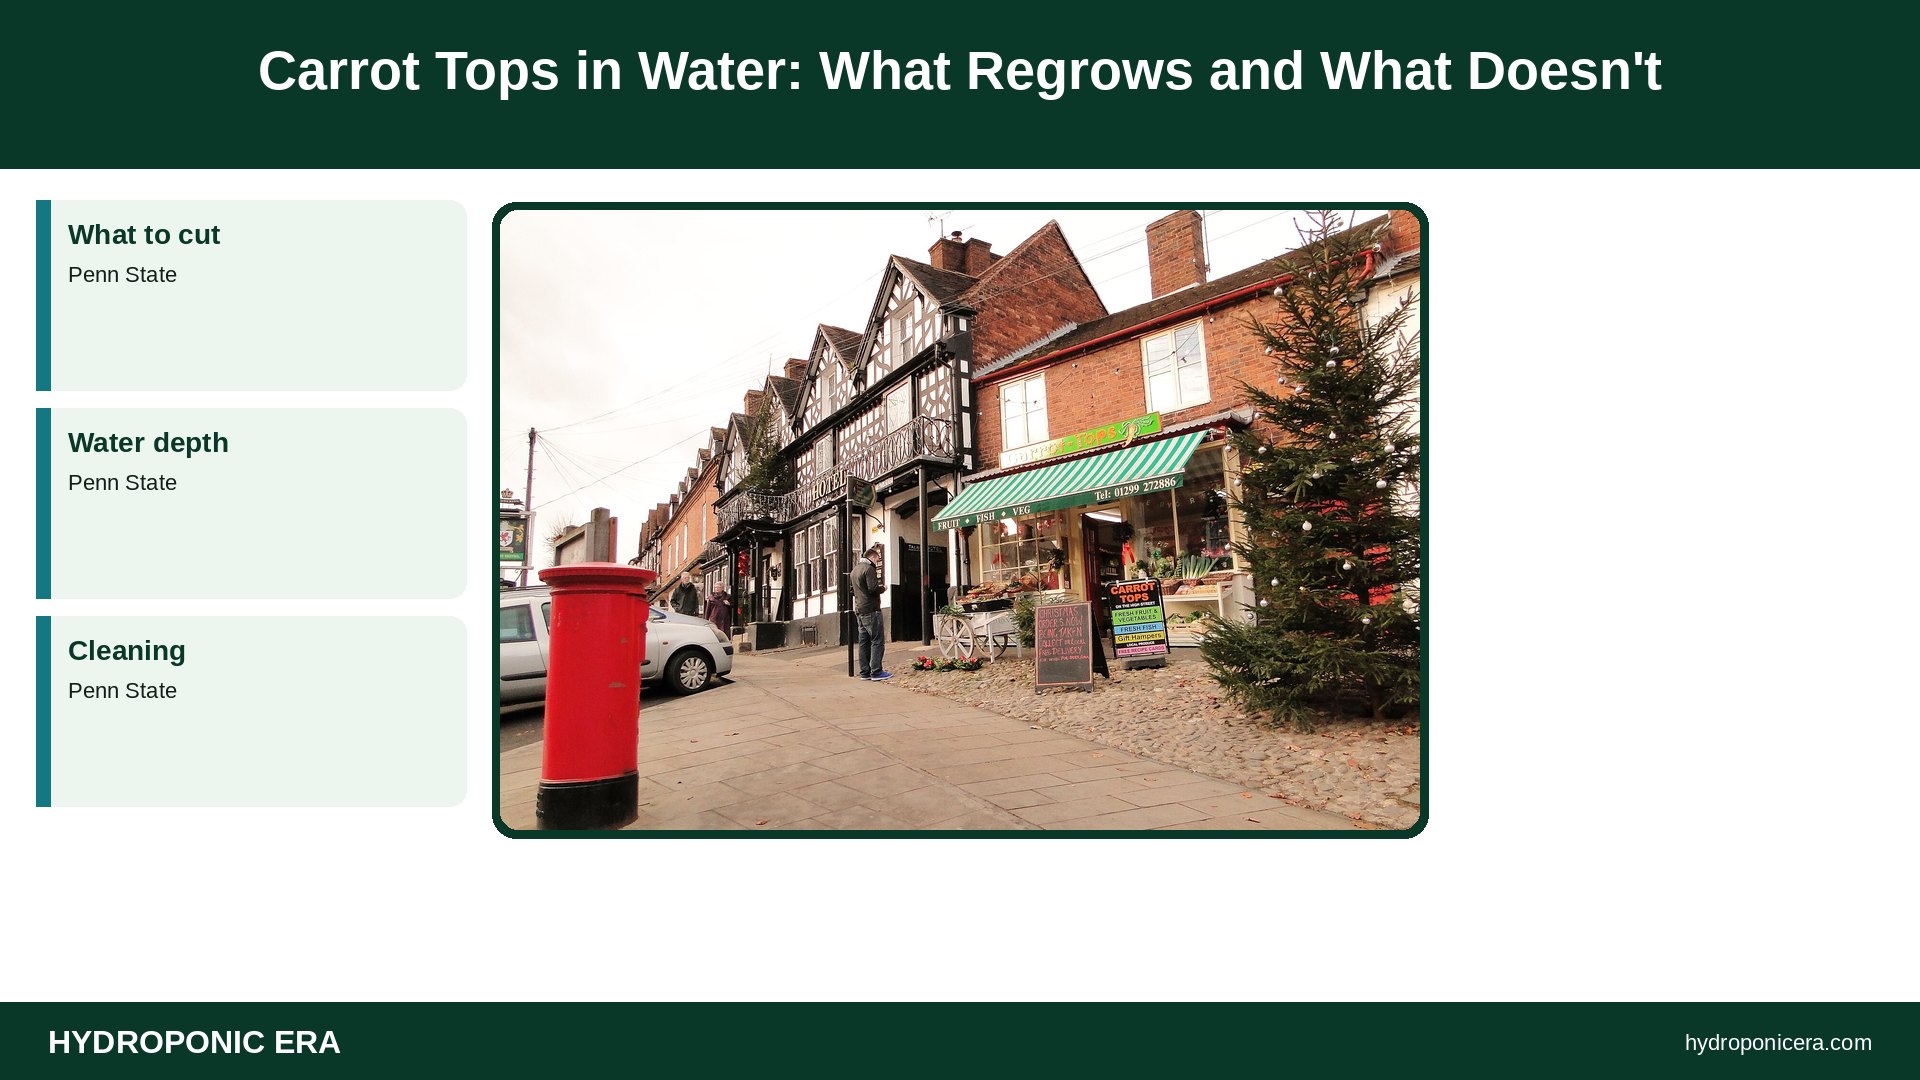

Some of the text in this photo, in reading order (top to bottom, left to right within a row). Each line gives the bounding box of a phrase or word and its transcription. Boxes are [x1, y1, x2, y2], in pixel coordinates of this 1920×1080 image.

[812, 469, 848, 501] HOTEL
[1094, 477, 1176, 500] Tel: 01299 272886
[937, 505, 1031, 531] FRUIT FISH VEG
[1110, 582, 1155, 595] CARROT
[1120, 592, 1149, 603] TOPS
[1039, 606, 1078, 619] CHRISTMAS
[1118, 615, 1157, 623] VEGETABLES
[1132, 633, 1162, 641] Hampers
